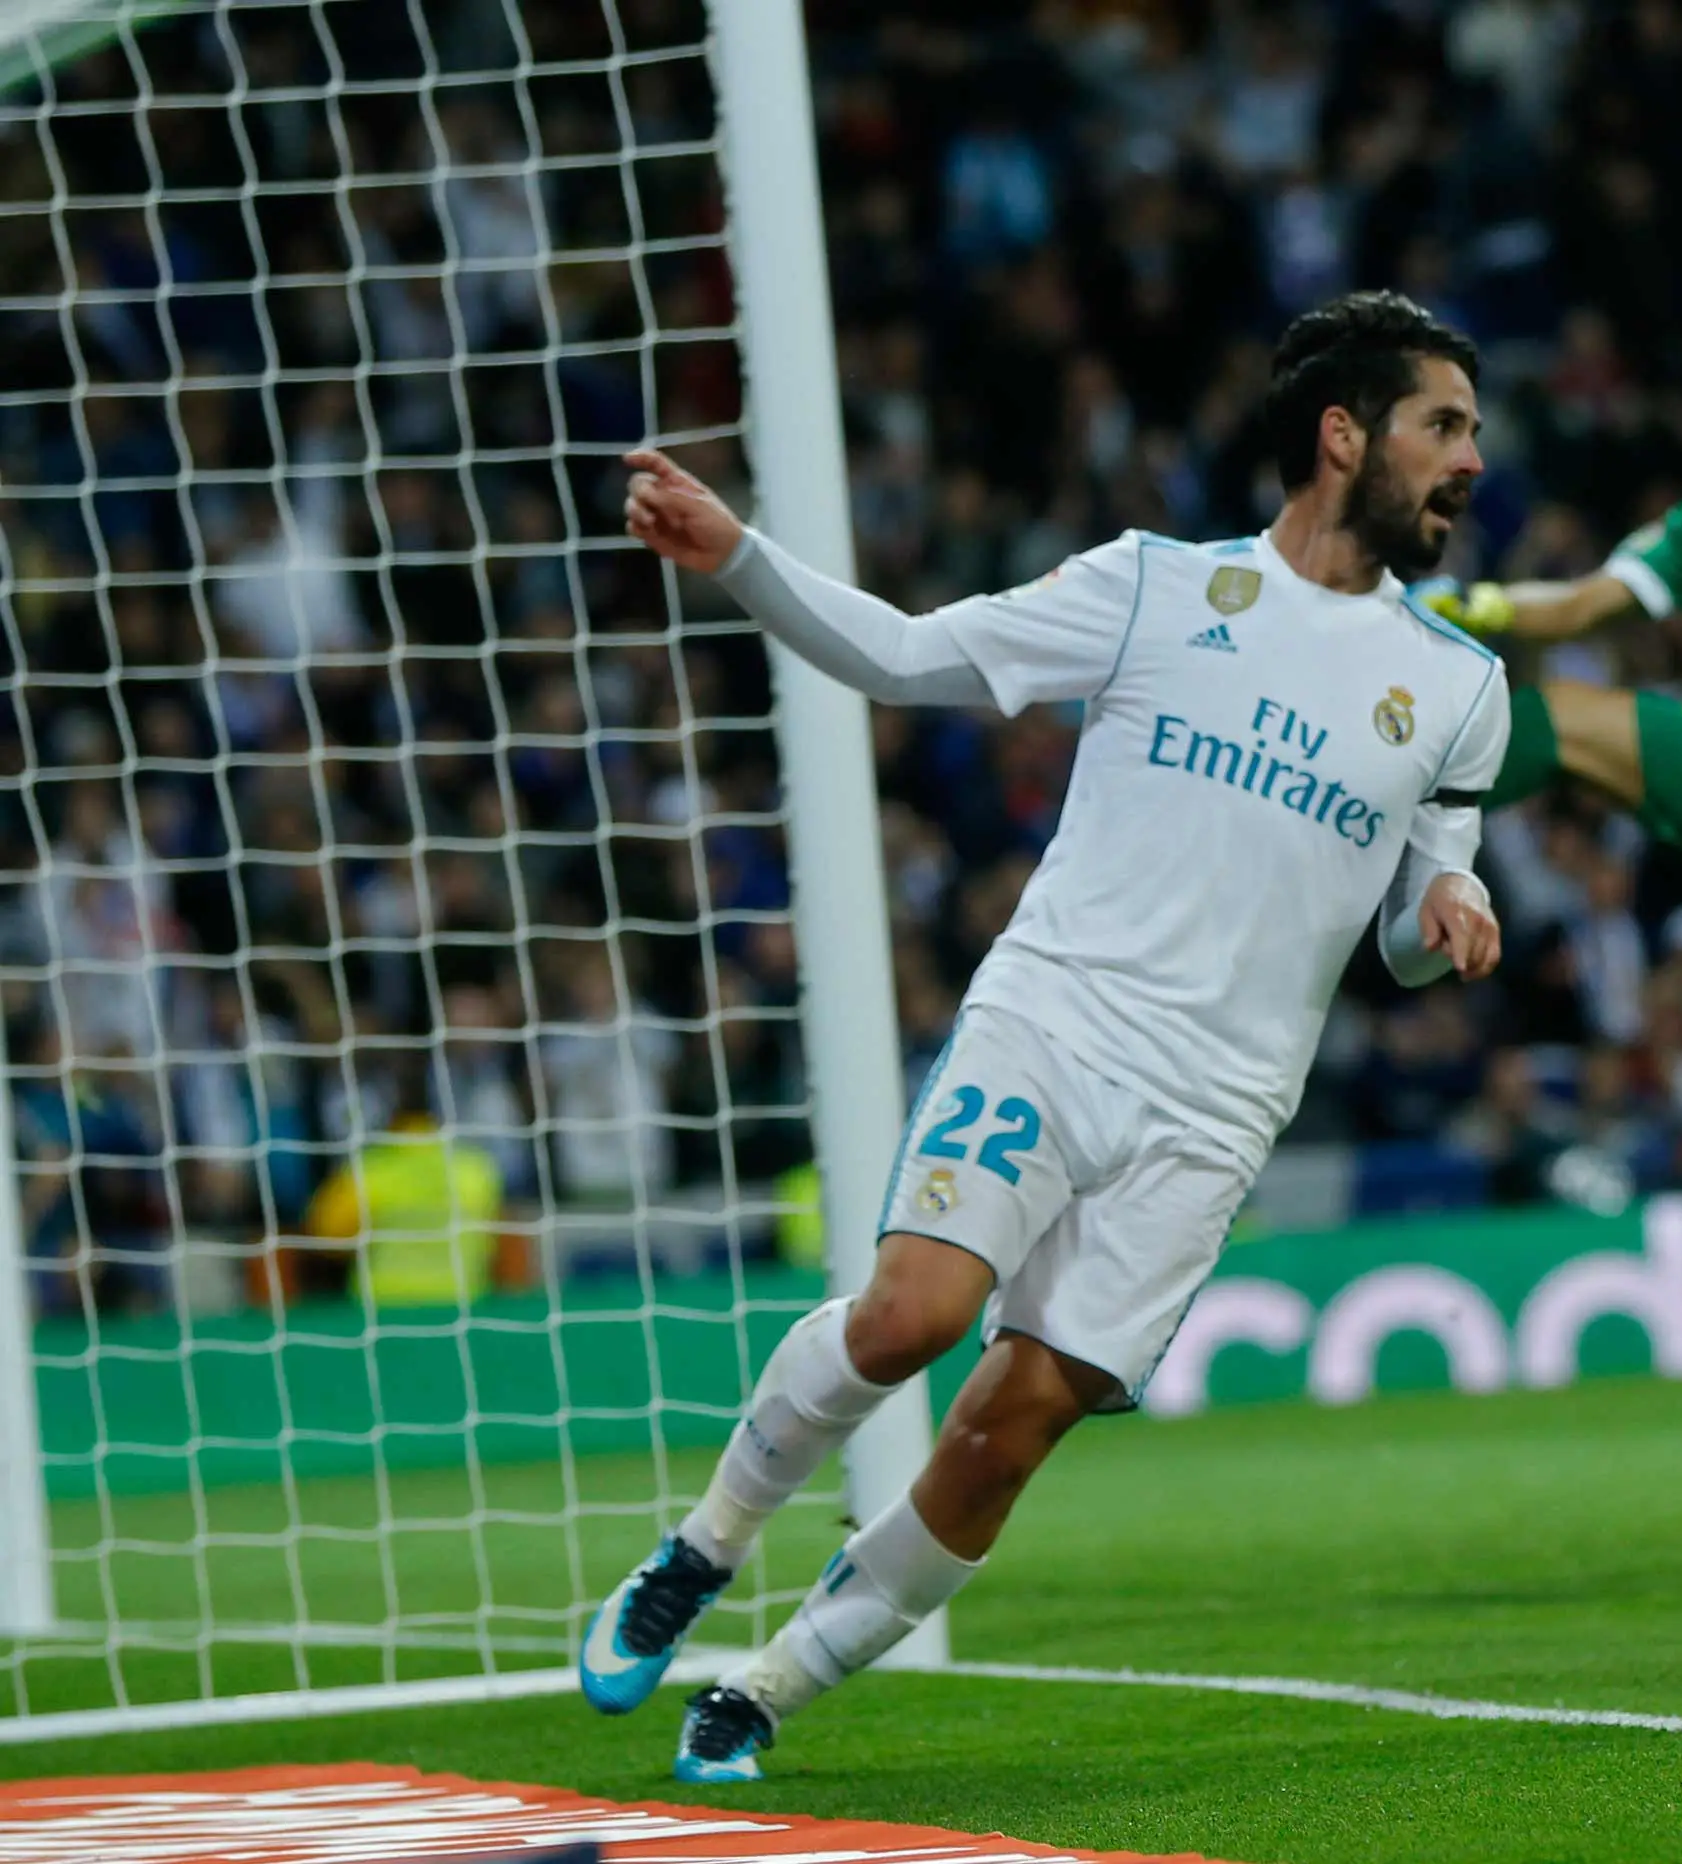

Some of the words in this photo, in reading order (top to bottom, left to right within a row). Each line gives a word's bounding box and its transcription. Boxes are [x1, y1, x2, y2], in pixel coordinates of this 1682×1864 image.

[1250, 696, 1329, 760] Fly
[1148, 713, 1386, 849] Emirates
[918, 1084, 1042, 1188] 22
